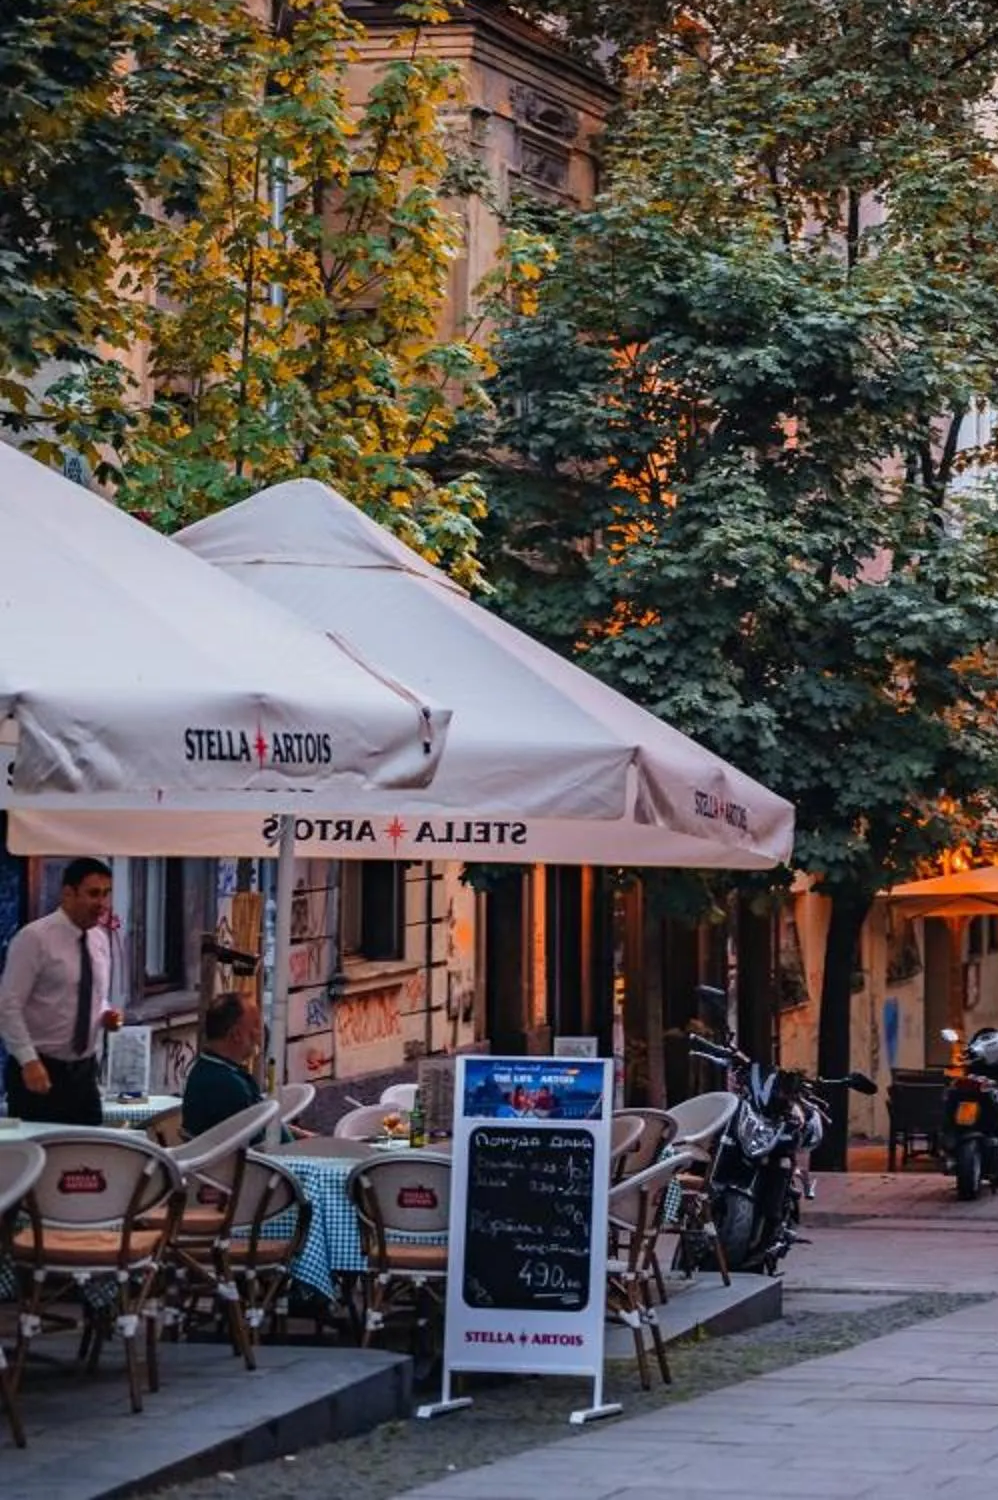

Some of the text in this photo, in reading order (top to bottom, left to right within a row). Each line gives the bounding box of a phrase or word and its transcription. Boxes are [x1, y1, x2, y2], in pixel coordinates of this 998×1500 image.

[184, 727, 332, 764] STELLA ARTOIS
[464, 1331, 584, 1347] STELLA ARTOIS
